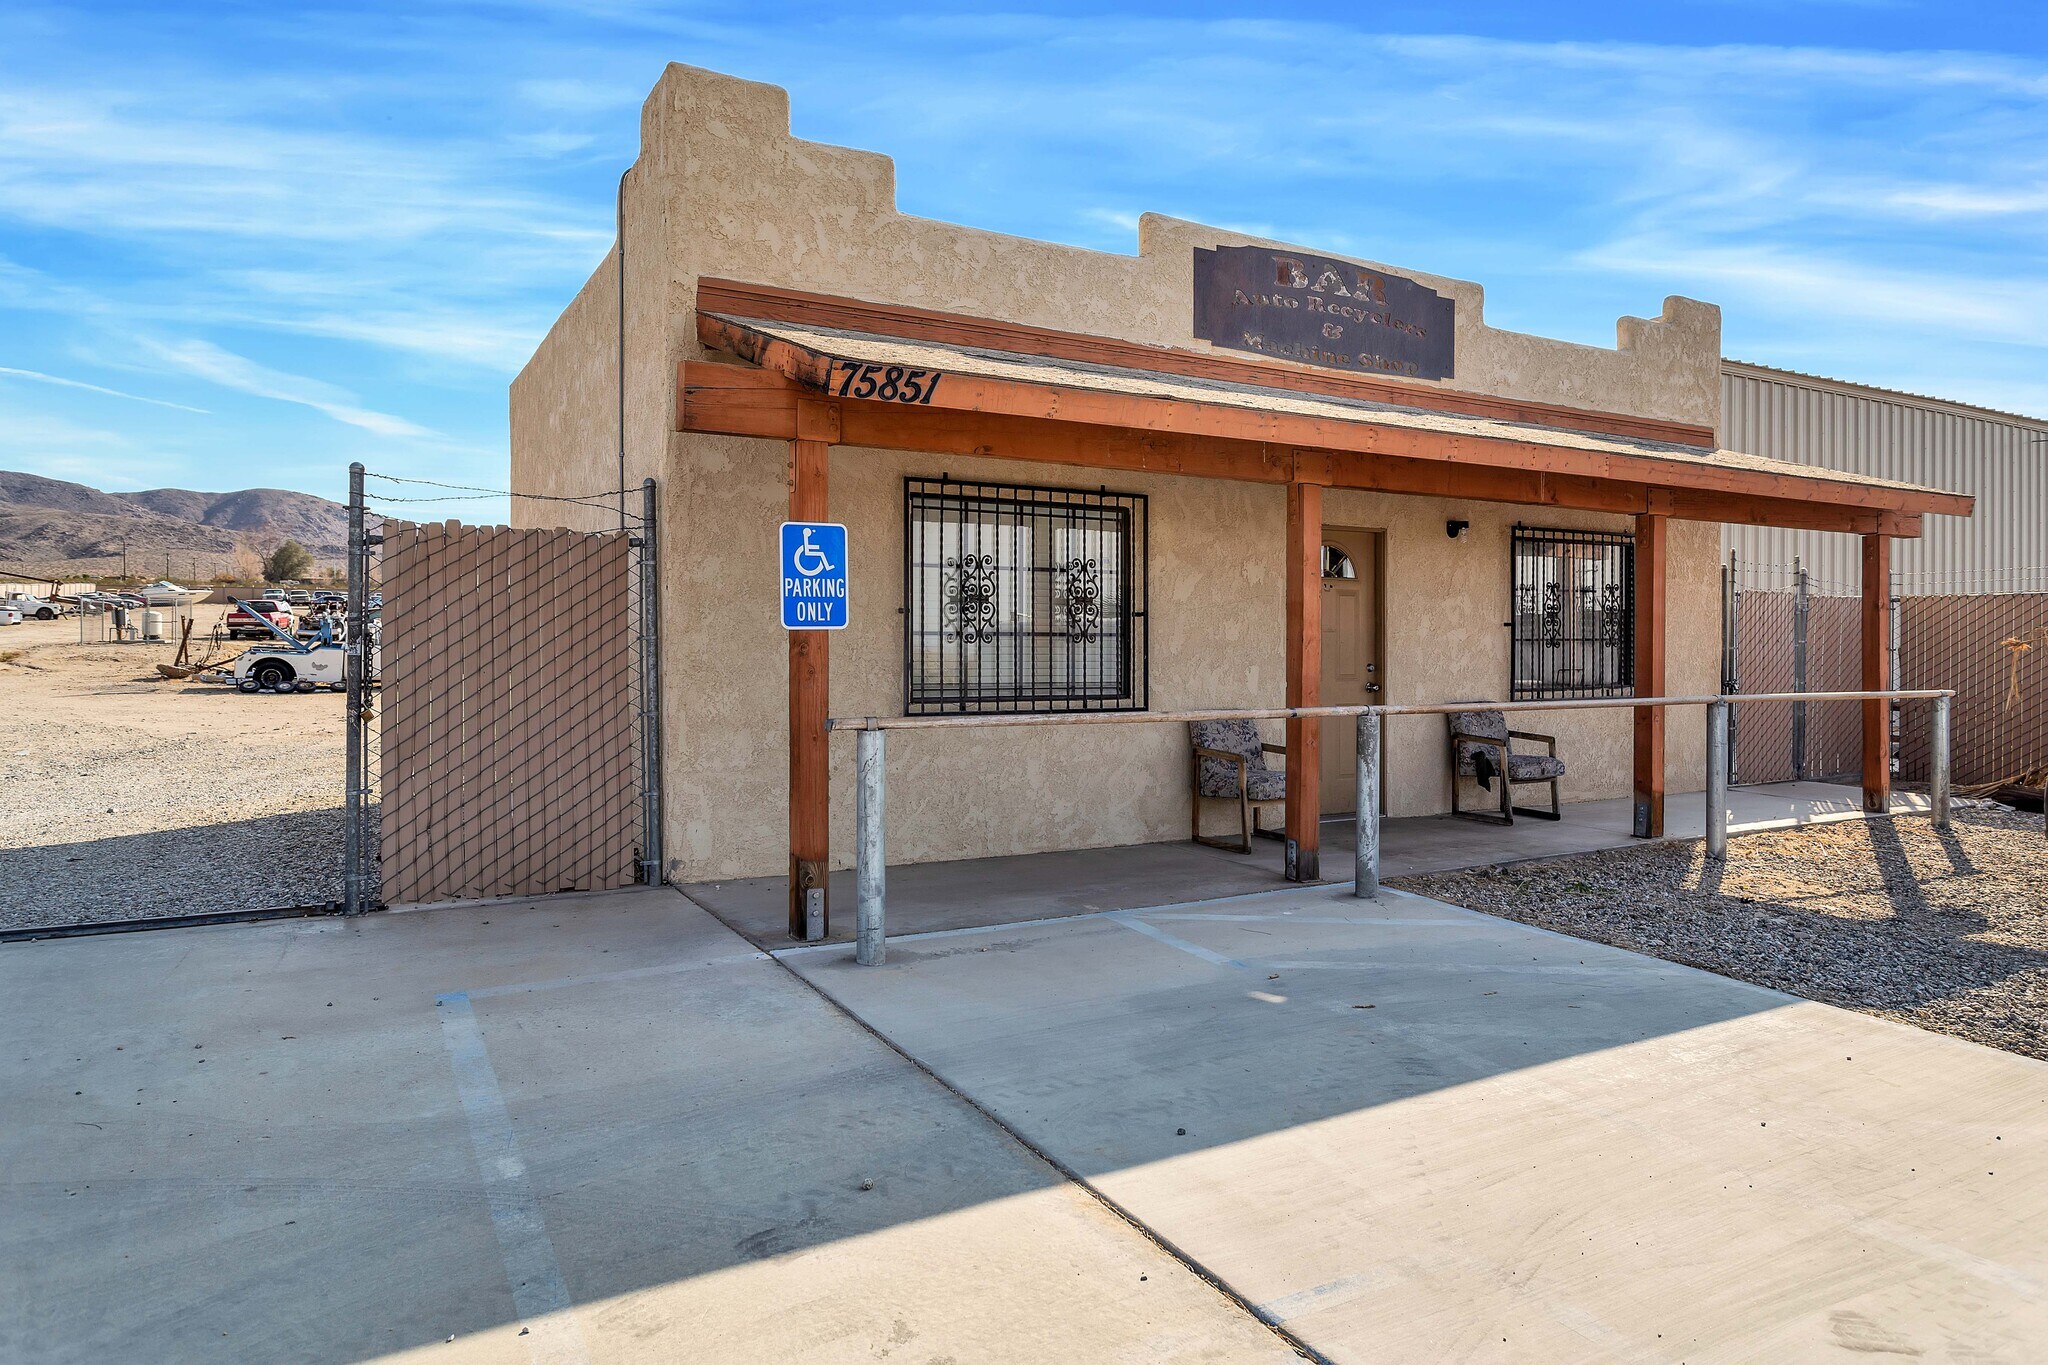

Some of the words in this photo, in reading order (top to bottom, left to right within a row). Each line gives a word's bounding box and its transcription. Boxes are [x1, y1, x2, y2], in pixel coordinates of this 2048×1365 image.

[1272, 255, 1388, 306] BAR
[1231, 288, 1299, 310] Auto
[1307, 295, 1427, 339] Recyclers
[1322, 322, 1344, 339] &
[1242, 331, 1350, 365] Machine
[1357, 352, 1419, 376] Shop
[839, 362, 941, 404] 75851
[785, 578, 844, 597] PARKING
[797, 602, 833, 621] ONLY
